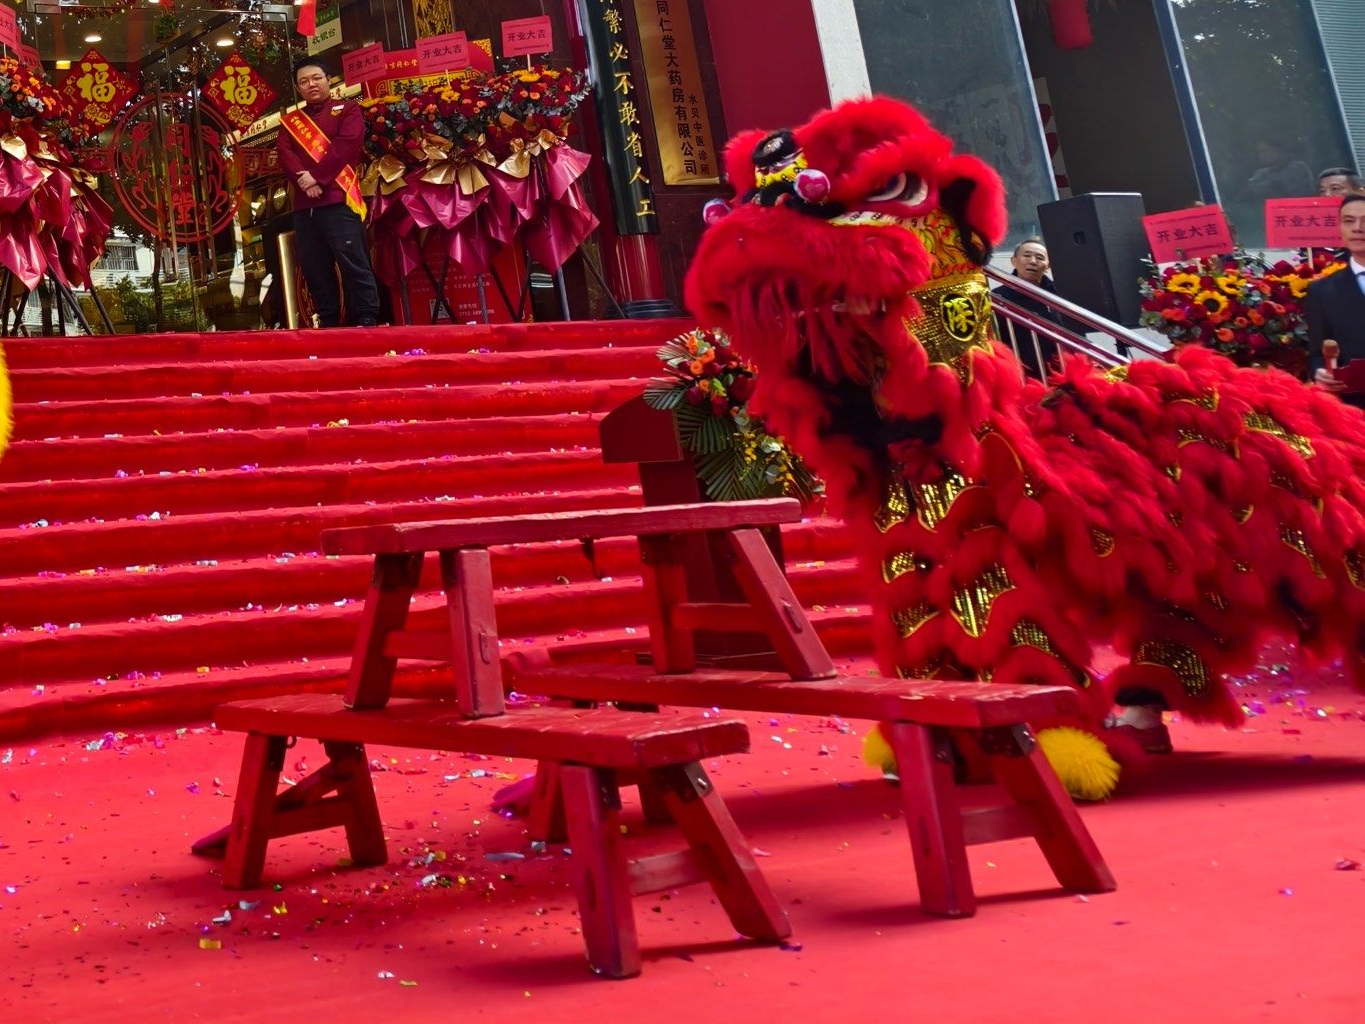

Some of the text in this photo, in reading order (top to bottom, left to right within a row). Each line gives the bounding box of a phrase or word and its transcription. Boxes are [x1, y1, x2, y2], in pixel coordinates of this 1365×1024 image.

[506, 29, 547, 43] 开业大吉
[422, 44, 463, 59] 开业大吉
[347, 54, 380, 73] 开业大吉
[76, 62, 116, 104] 福
[219, 65, 258, 106] 福
[1274, 214, 1337, 228] 开业大吉
[1157, 223, 1219, 243] 开业大吉
